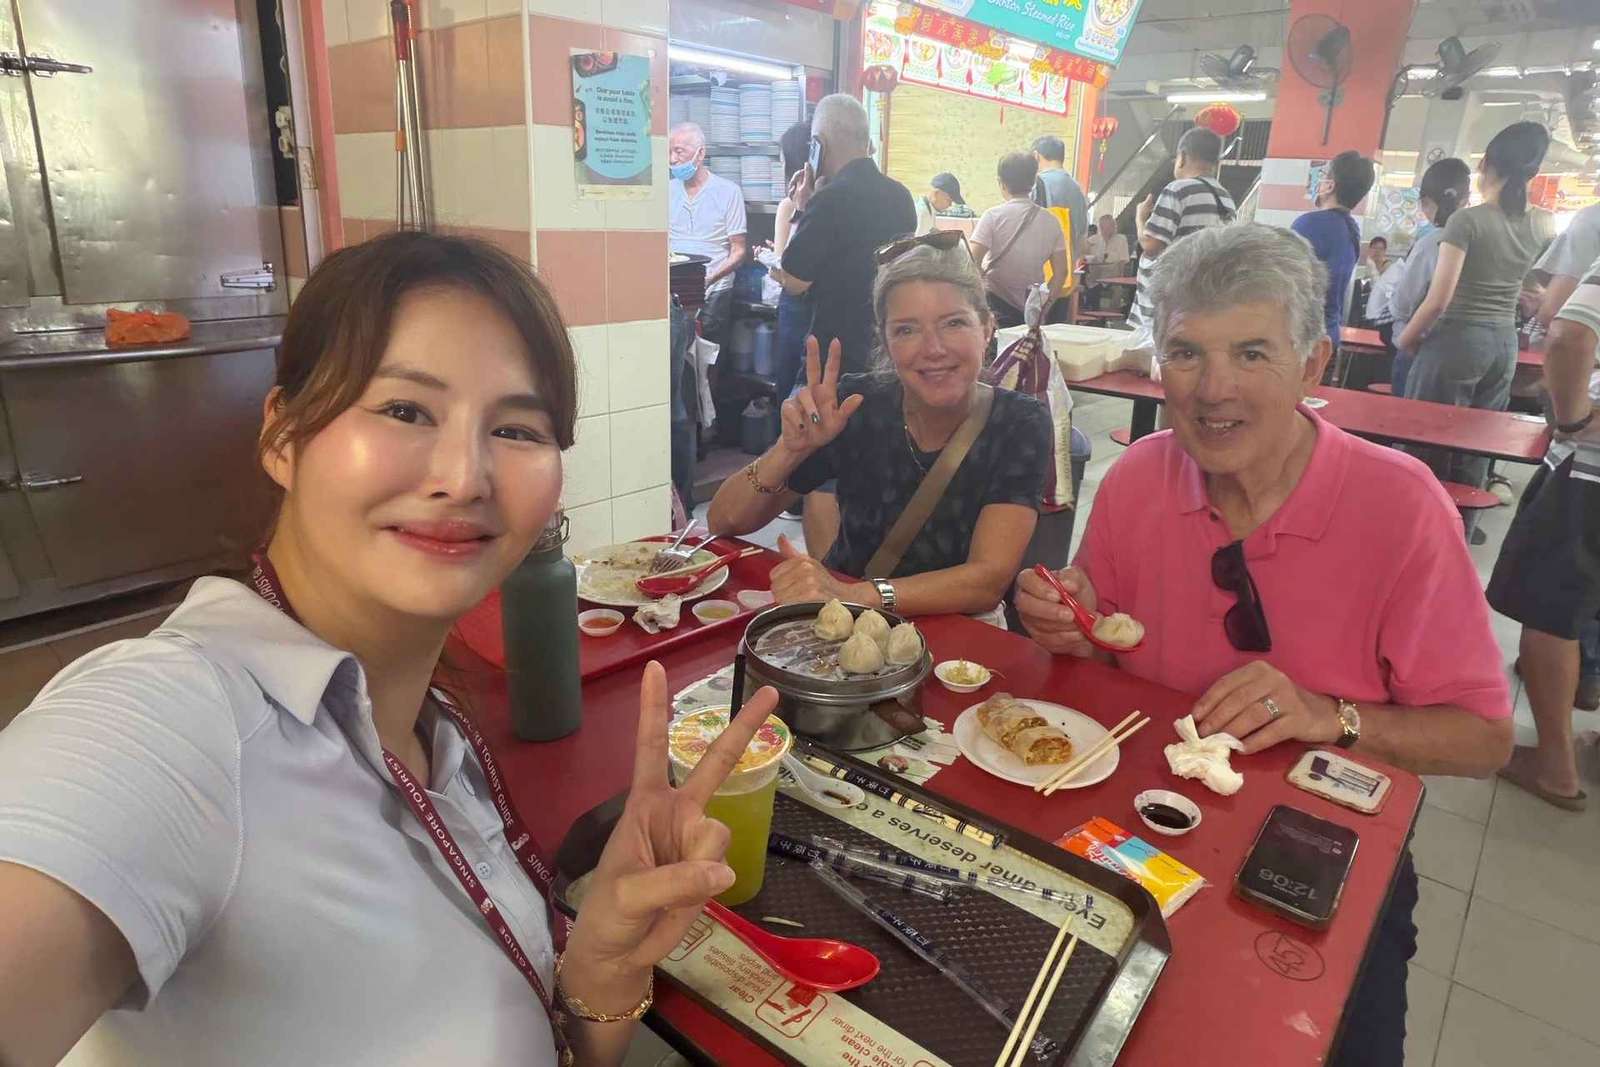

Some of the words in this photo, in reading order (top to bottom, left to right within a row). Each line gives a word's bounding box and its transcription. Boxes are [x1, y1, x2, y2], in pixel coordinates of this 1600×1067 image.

[385, 756, 427, 812] TOURIST
[480, 744, 502, 792] TOURIST
[497, 793, 515, 829] GUIDE
[871, 808, 886, 819] a
[887, 817, 978, 864] deserves
[424, 812, 478, 889] SINGAPORE
[727, 984, 755, 1003] Clear
[831, 1016, 856, 1034] diner
[841, 1034, 871, 1057] clean
[854, 1031, 877, 1048] next
[841, 1051, 860, 1067] the
[876, 1044, 893, 1059] the
